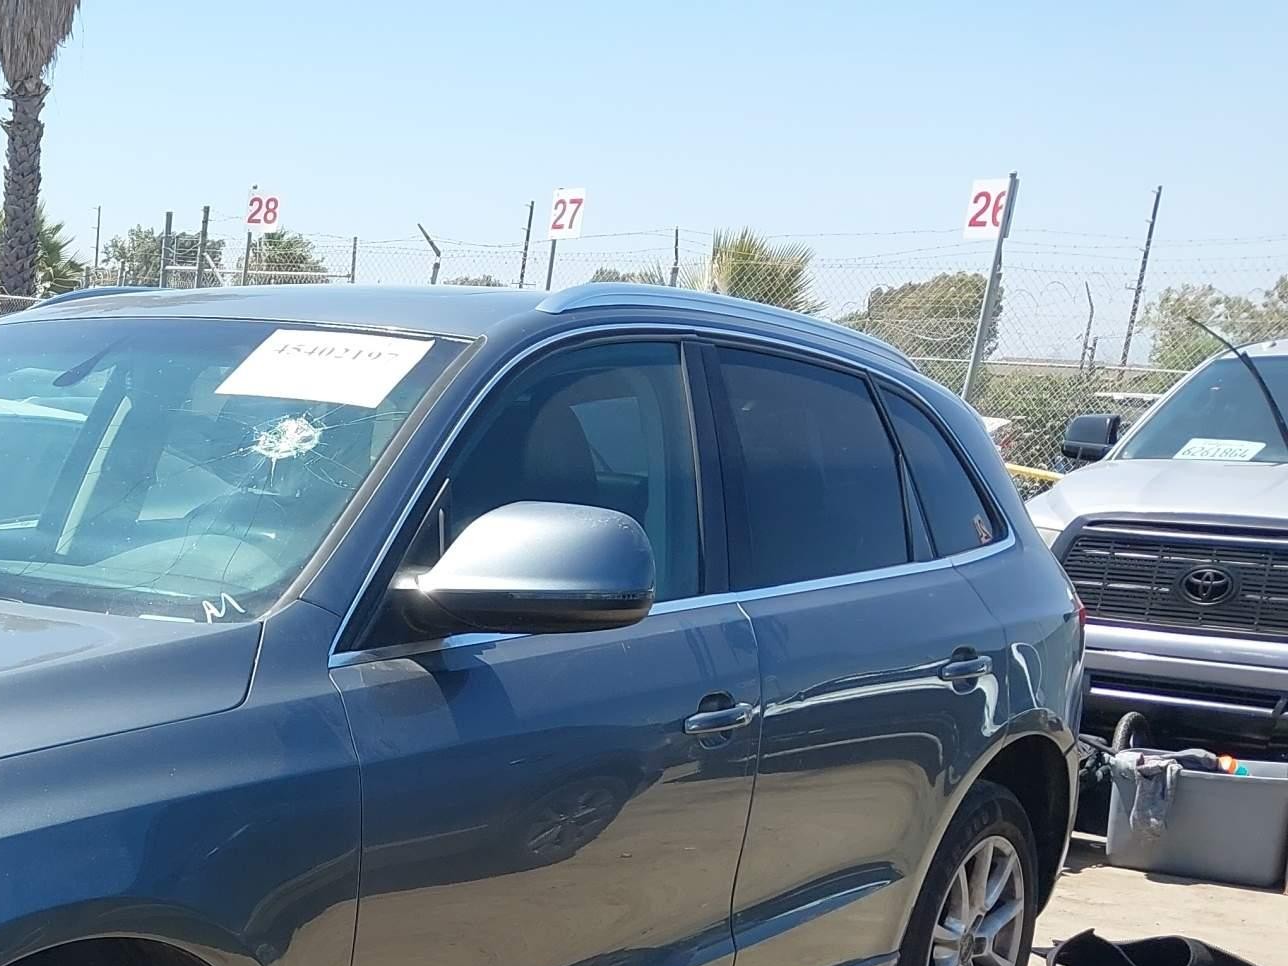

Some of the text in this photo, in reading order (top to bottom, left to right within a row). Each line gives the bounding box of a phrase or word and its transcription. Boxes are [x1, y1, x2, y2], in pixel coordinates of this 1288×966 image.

[247, 196, 279, 224] 28
[551, 198, 583, 229] 27
[274, 343, 400, 361] 45402197
